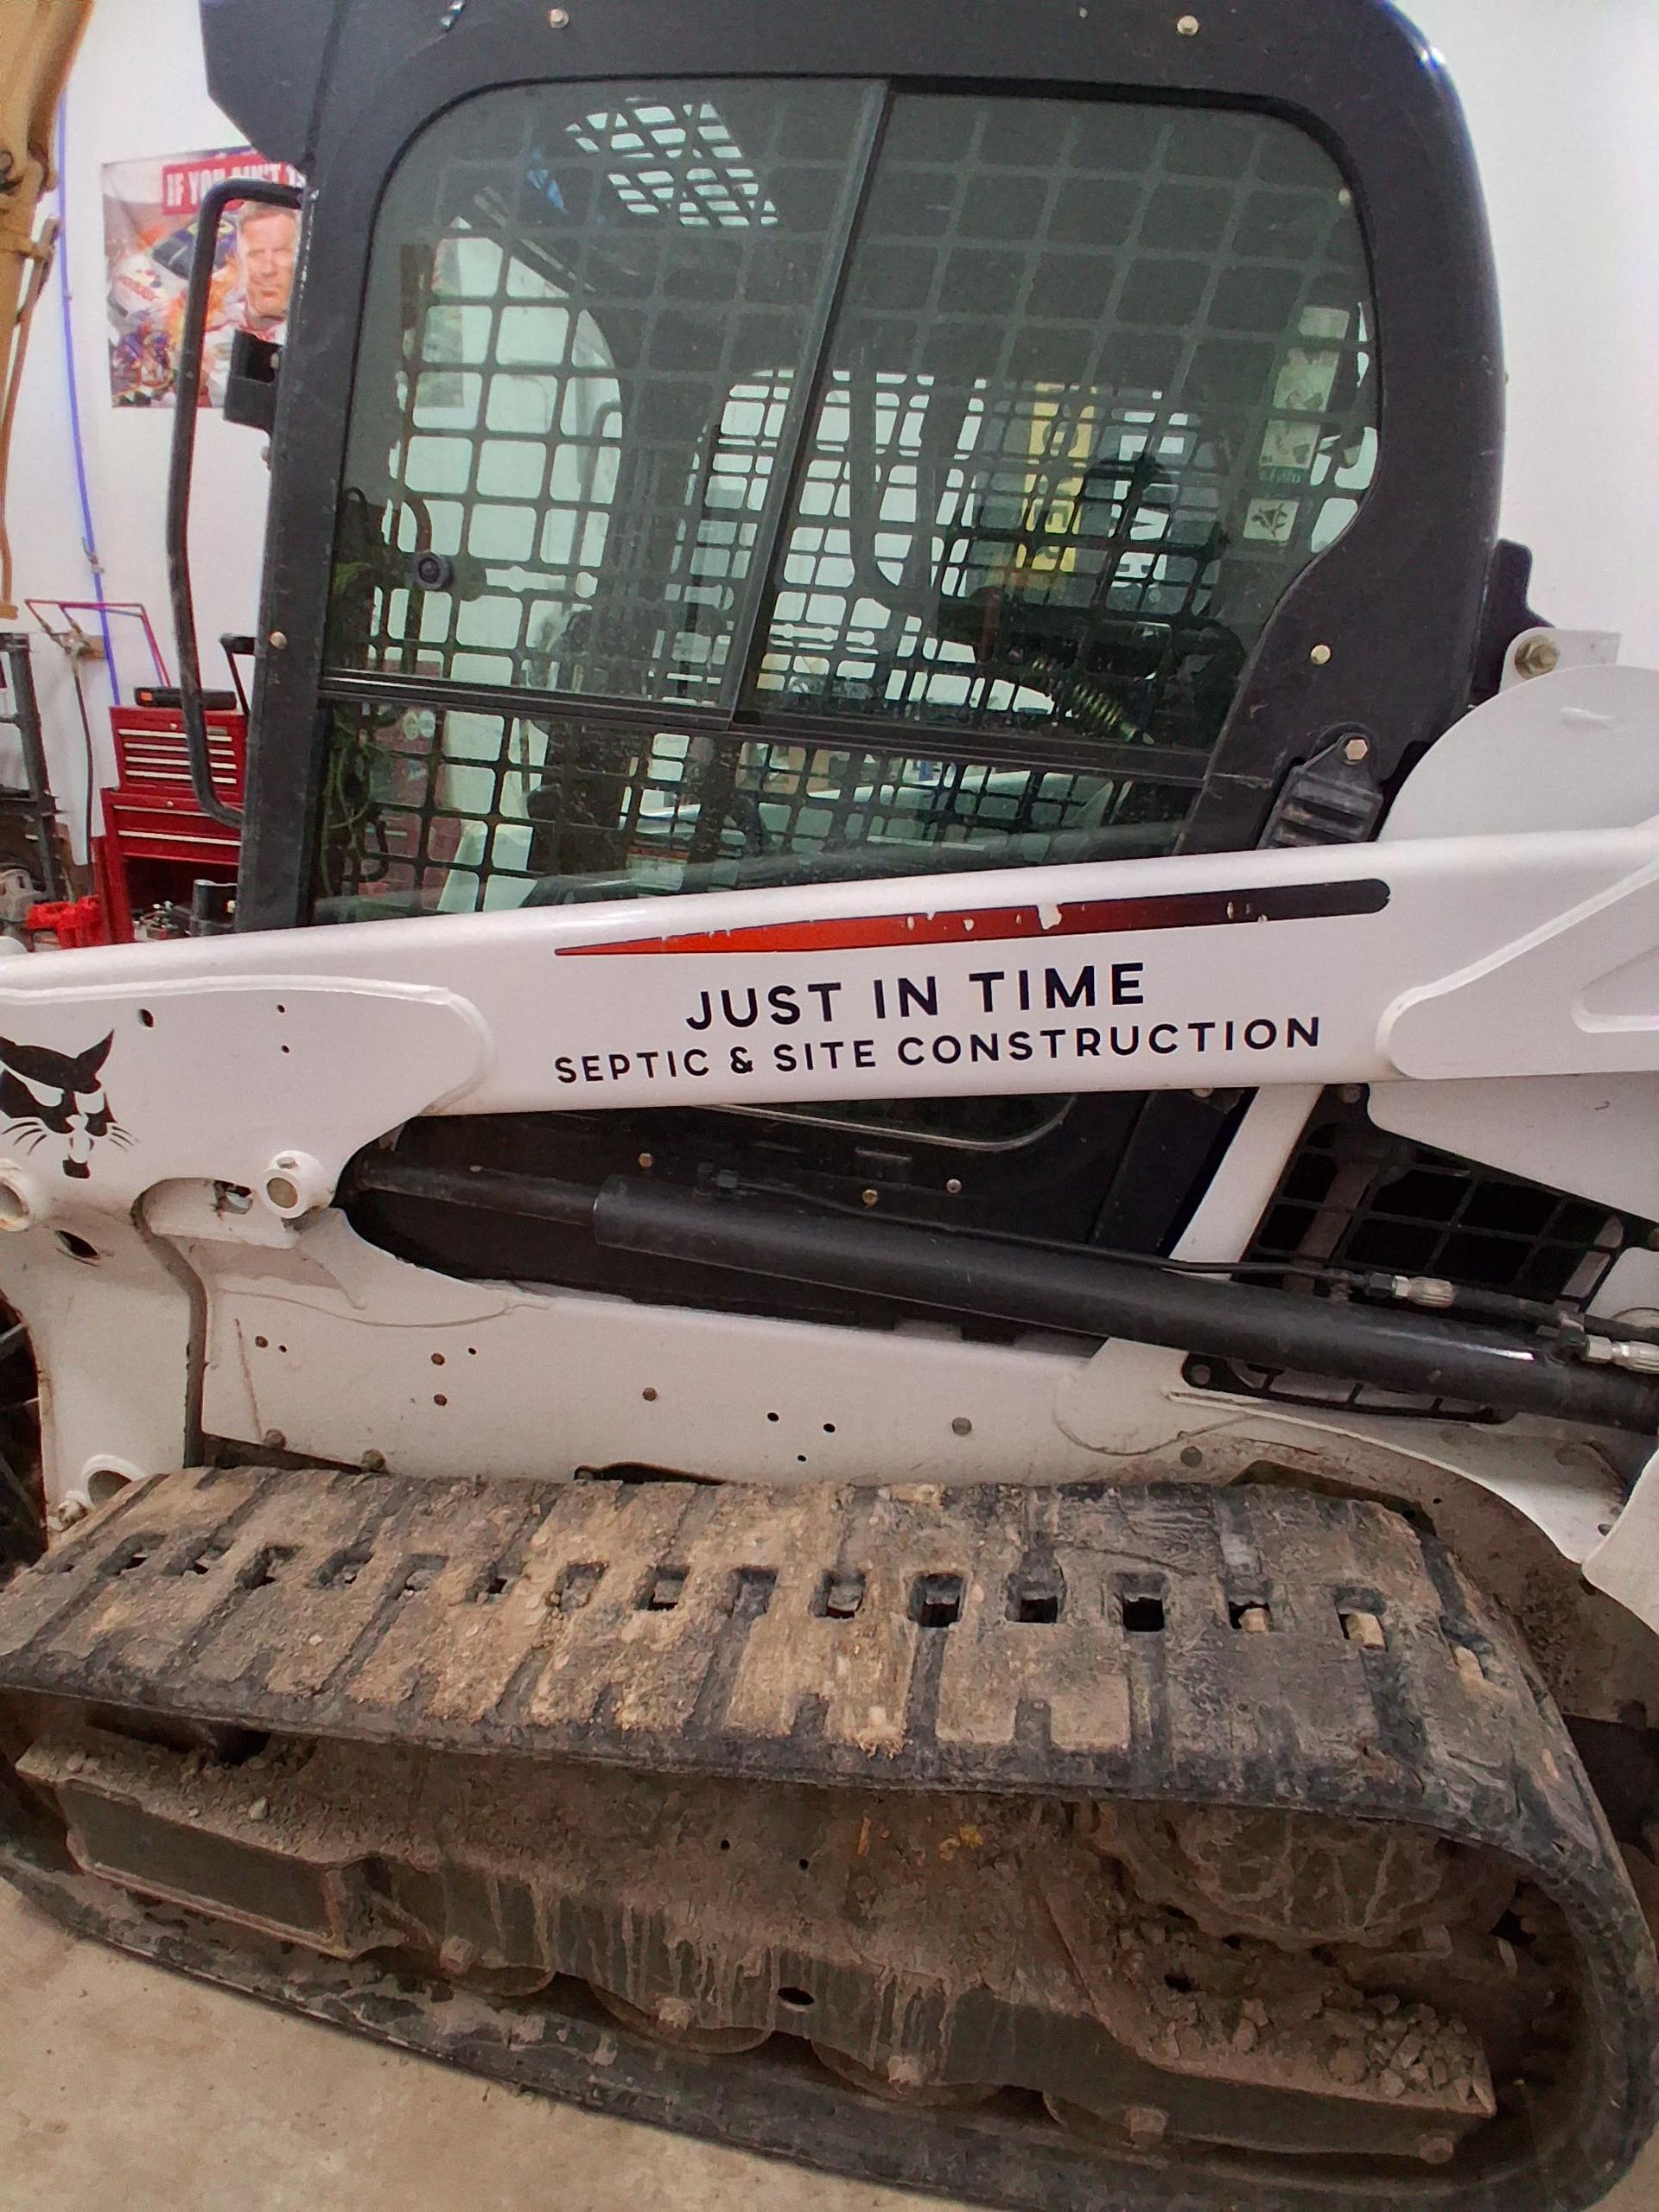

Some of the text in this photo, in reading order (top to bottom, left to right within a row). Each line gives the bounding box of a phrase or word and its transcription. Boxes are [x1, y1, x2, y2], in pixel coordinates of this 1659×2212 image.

[166, 172, 184, 207] IF
[685, 962, 1145, 1032] JUST IN TIME
[554, 1016, 1320, 1084] SEPTIC & SITE CONSTRUCTION
